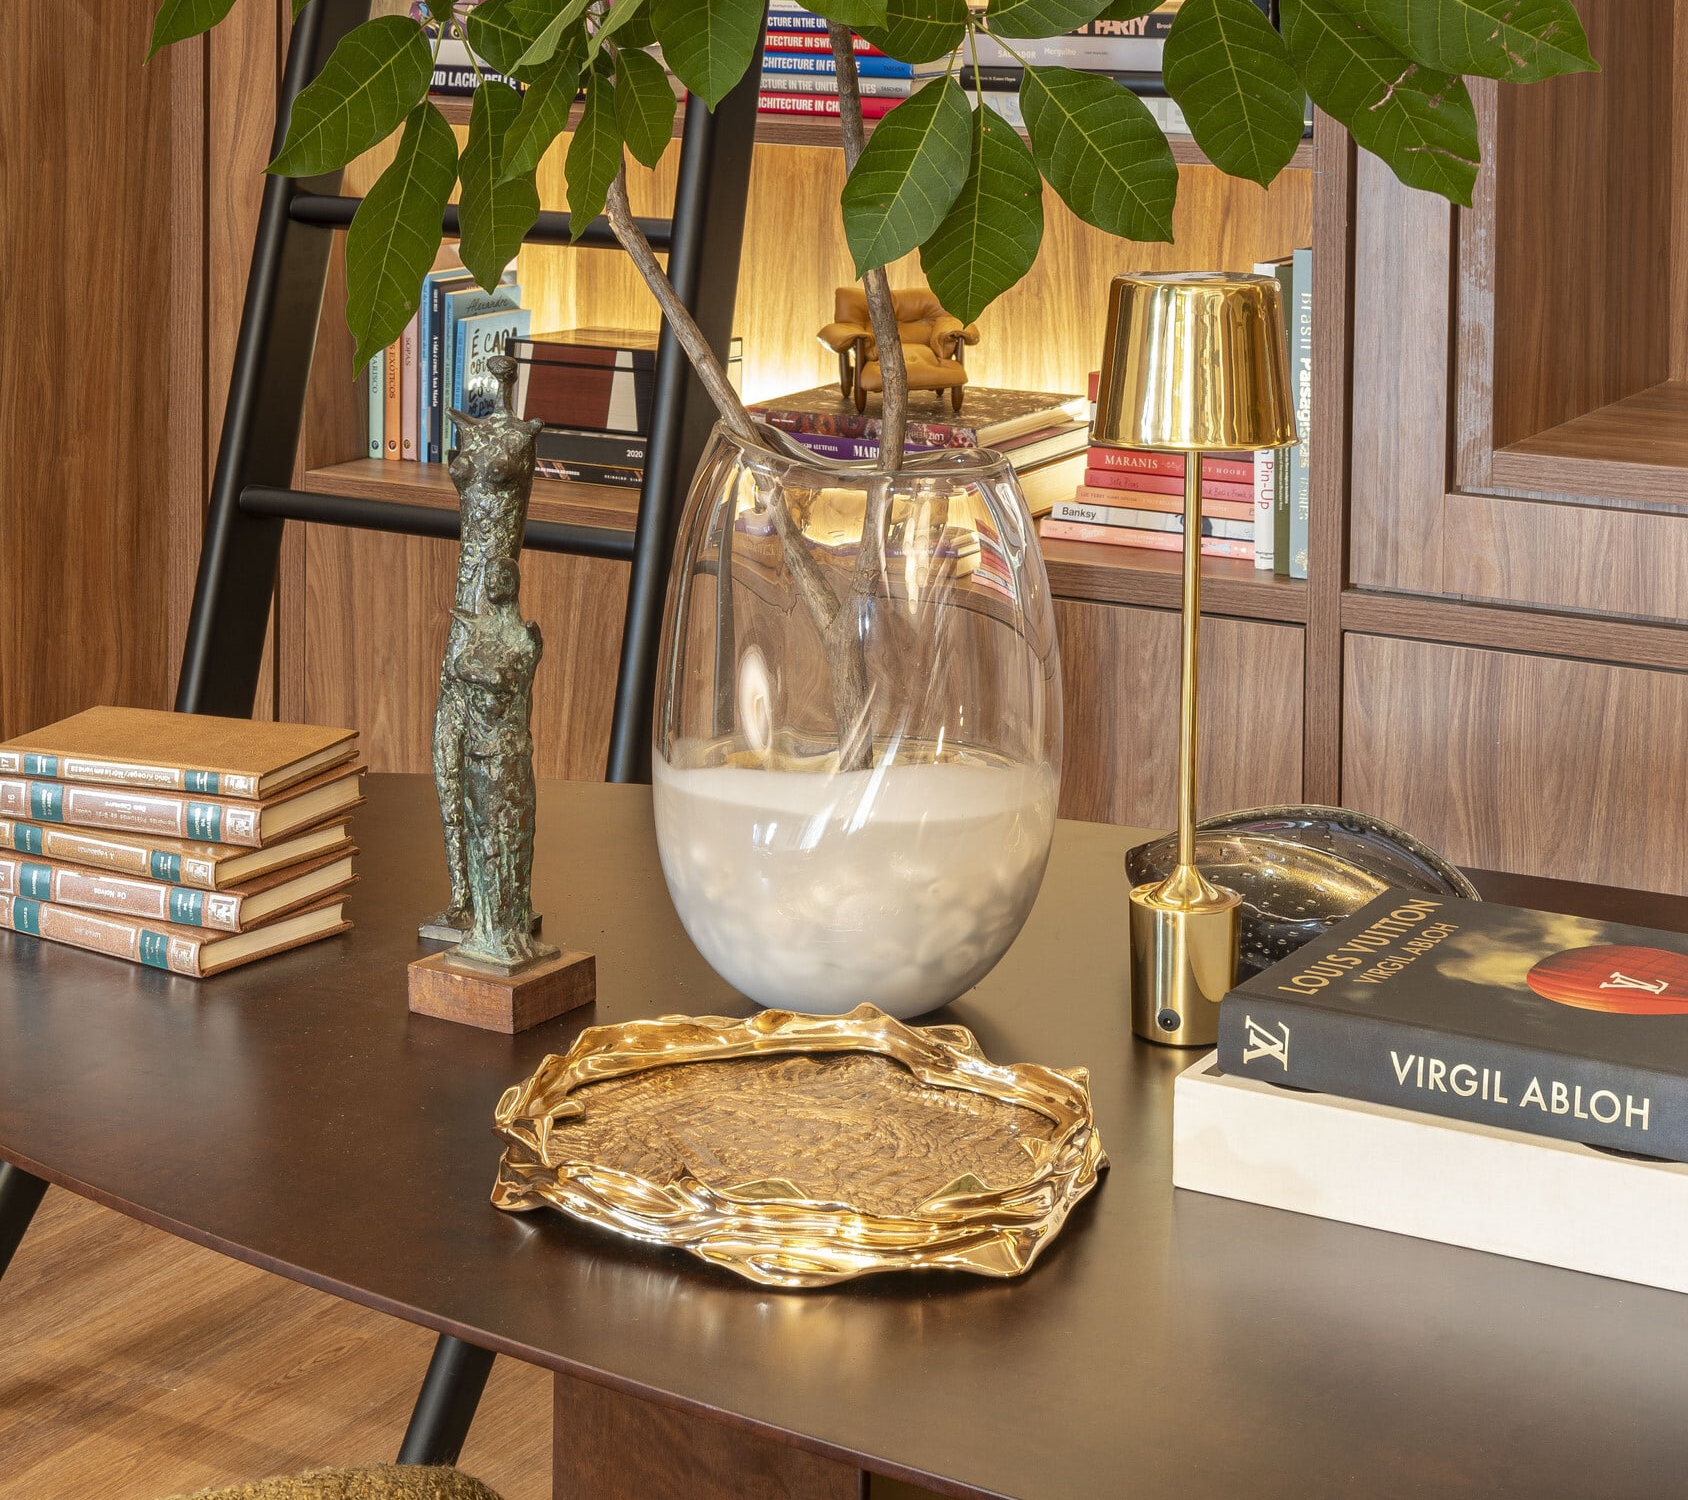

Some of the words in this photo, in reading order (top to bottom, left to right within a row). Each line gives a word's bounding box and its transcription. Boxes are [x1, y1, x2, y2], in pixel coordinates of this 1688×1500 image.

[793, 17, 802, 27] IN
[801, 18, 816, 28] THE
[1094, 15, 1150, 36] PARTY
[765, 35, 803, 47] ITECTURE
[804, 37, 813, 47] IN
[1044, 47, 1077, 56] Mergulho
[762, 56, 814, 70] CHITECTURE
[816, 59, 825, 71] IN
[429, 70, 447, 86] VID
[788, 80, 798, 90] IN
[798, 80, 813, 90] THE
[815, 81, 838, 92] UNITE
[758, 97, 812, 111] RCHITECTURE
[814, 100, 824, 111] IN
[466, 298, 508, 314] Alexandre
[472, 328, 480, 358] É
[371, 354, 379, 394] ARISCO
[626, 449, 643, 458] 2020
[1104, 454, 1158, 470] MARANIS
[1215, 466, 1247, 476] MOORE
[1260, 460, 1274, 510] Pin-Up
[1062, 506, 1096, 520] Banksy
[8, 794, 16, 804] 16
[93, 887, 115, 898] Noivos
[1277, 946, 1363, 997] LOUIS
[1347, 898, 1444, 956] VUITTON
[1353, 951, 1414, 985] VIRGIL
[1401, 922, 1460, 966] ABLOH
[1390, 1051, 1508, 1104] VIRGIL
[1519, 1077, 1650, 1131] ABLOH
